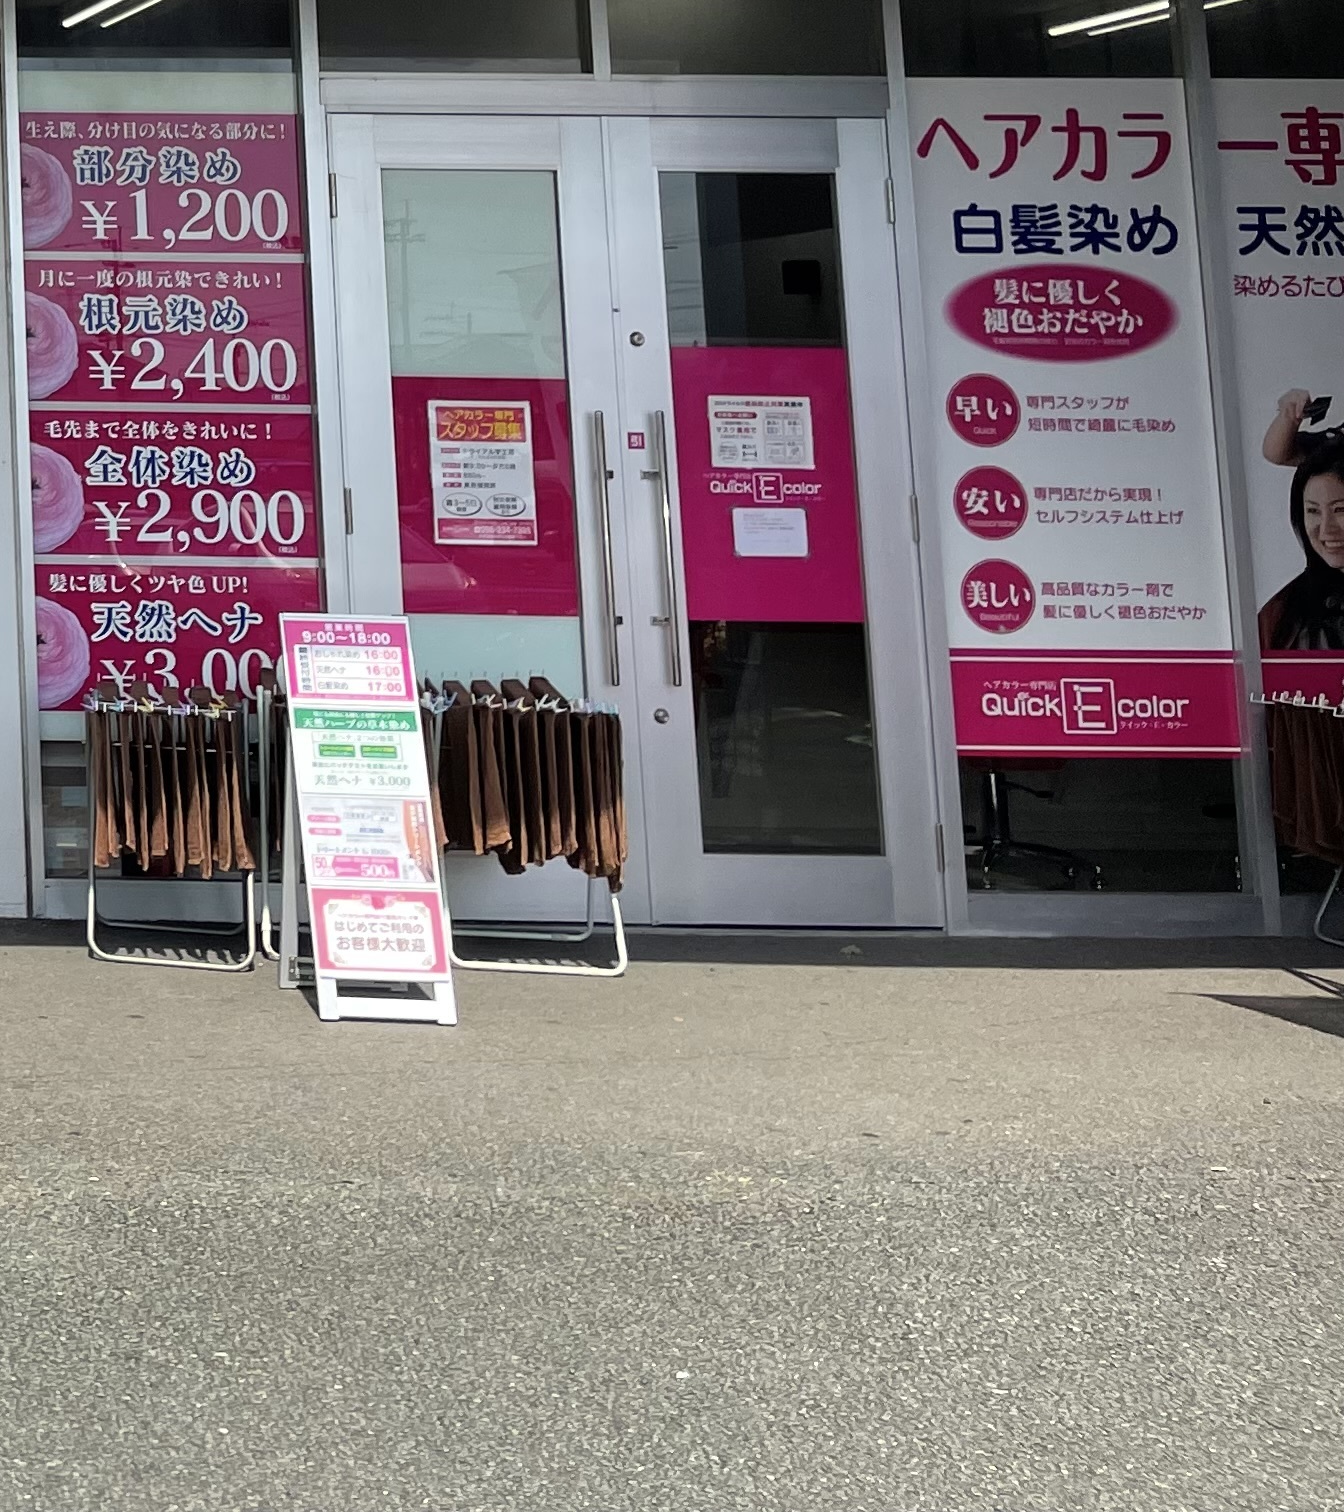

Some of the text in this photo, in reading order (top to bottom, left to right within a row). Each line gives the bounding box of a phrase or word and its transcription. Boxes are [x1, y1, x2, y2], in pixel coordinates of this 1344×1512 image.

[73, 145, 242, 185] 部分染め
[79, 188, 289, 249] ¥1,200
[952, 202, 1179, 256] 白髪染め
[993, 277, 1123, 306] 髪に優しく
[79, 293, 250, 335] 根元染め
[86, 337, 298, 400] ¥2,400
[954, 395, 1013, 423] 早い
[1026, 395, 1130, 411] 専門スタッフが
[85, 445, 257, 486] 全体染め
[709, 479, 753, 494] Quick
[782, 481, 823, 495] color
[962, 486, 1021, 516] 安い
[92, 488, 306, 552] ¥2,900
[1035, 509, 1184, 525] セルフシステム仕上げ
[965, 579, 1031, 610] 美しい
[91, 599, 263, 643] 天然ヘナ
[364, 649, 399, 661] 16:00
[366, 665, 401, 677] 16:00
[368, 681, 403, 693] 17:00
[981, 691, 1062, 719] Quick
[1116, 695, 1190, 720] color
[314, 774, 363, 786] 天然ヘナ
[334, 920, 425, 935] はじめてご利用の
[335, 935, 427, 952] お客様大歓迎
